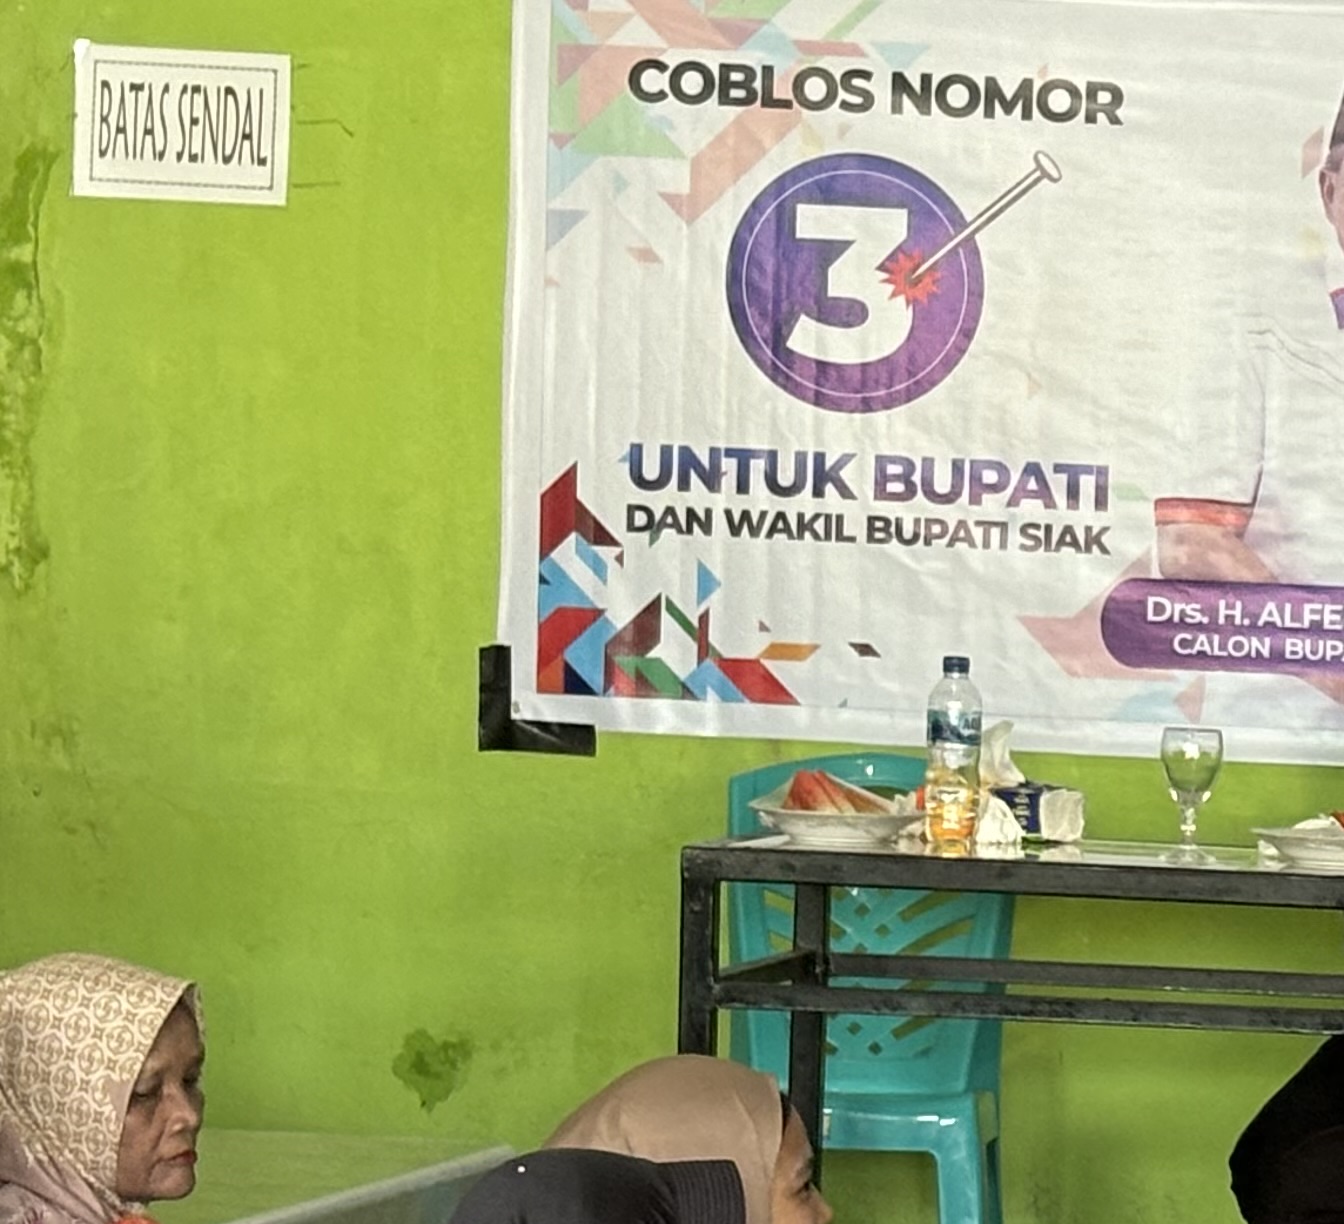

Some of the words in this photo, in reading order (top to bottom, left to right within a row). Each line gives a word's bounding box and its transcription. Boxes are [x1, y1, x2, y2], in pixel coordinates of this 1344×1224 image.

[98, 80, 168, 161] BATAS
[176, 84, 268, 167] SENDAL
[628, 58, 874, 114] COBLOS
[891, 71, 1125, 126] NOMOR
[786, 202, 914, 365] 3
[628, 443, 857, 500] UNTUK
[874, 456, 1110, 511] BUPATI
[626, 504, 713, 536] DAN
[724, 508, 856, 542] WAKIL
[867, 514, 1008, 551] BUPATI
[1019, 520, 1111, 555] SIAK
[1147, 596, 1209, 625] Drs.
[1217, 600, 1251, 627] H.
[1173, 633, 1270, 660] CALON
